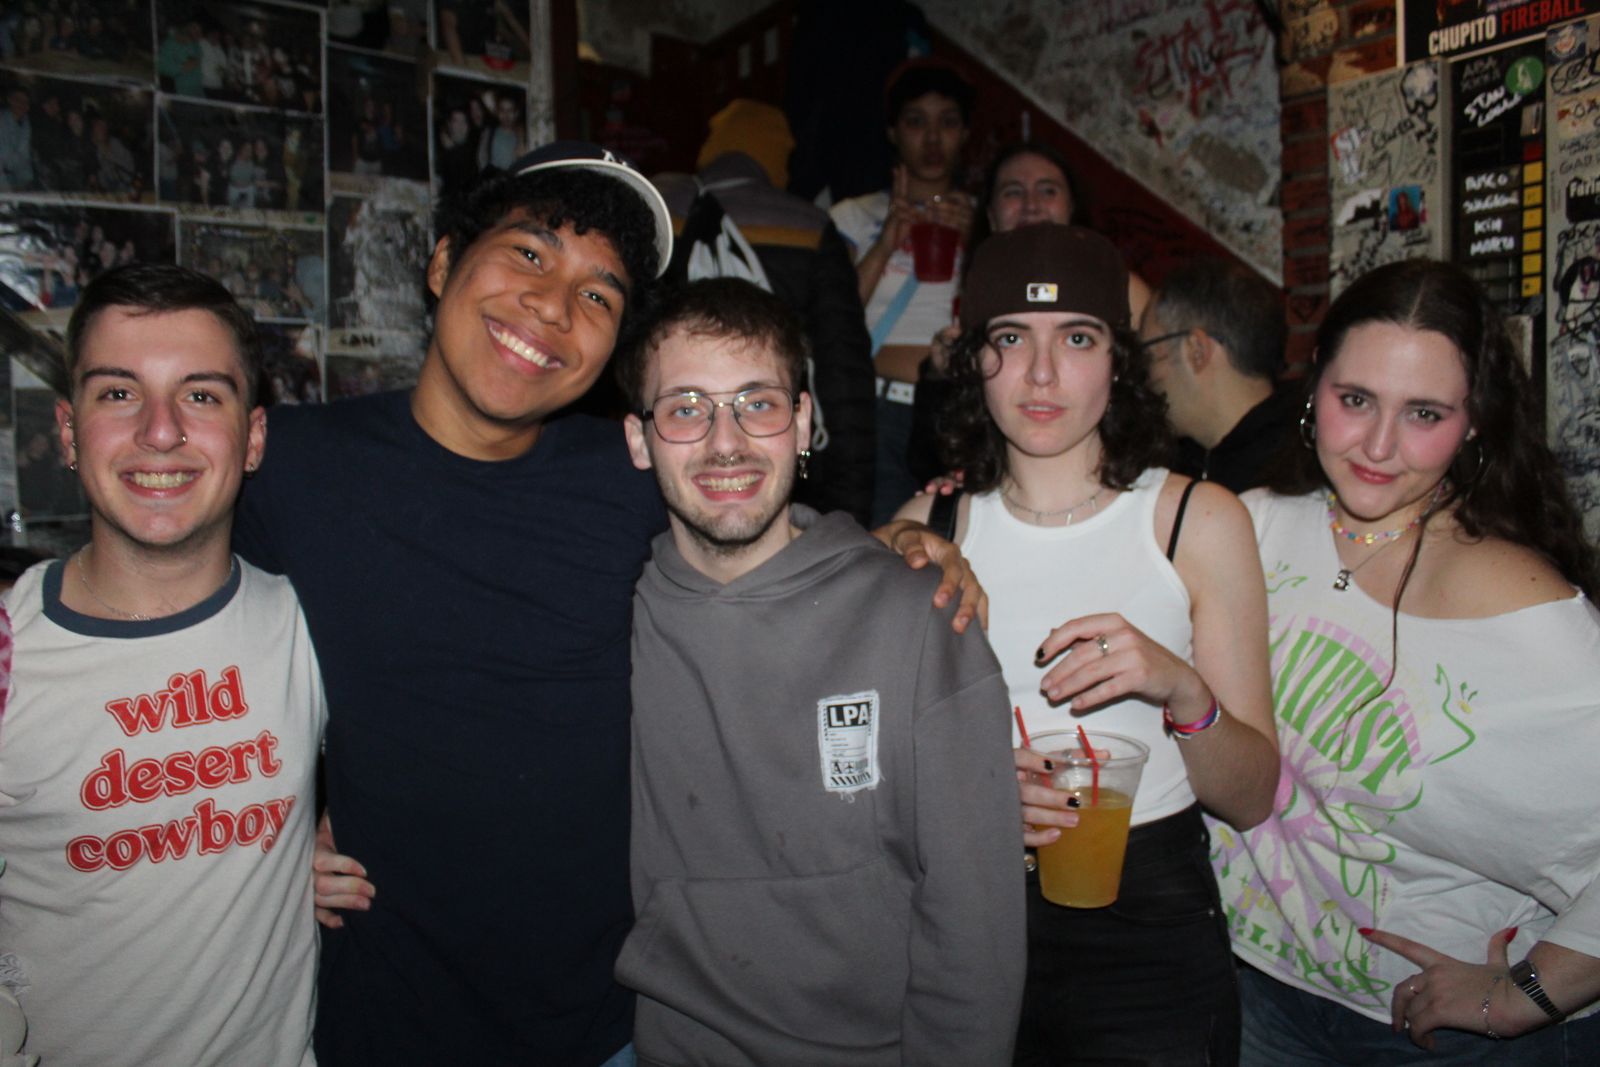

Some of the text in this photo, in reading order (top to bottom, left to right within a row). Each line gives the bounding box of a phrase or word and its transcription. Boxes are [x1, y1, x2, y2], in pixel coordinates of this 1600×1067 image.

[1428, 0, 1585, 56] CHUPITO FIREBALL
[105, 665, 248, 736] wild
[829, 704, 869, 727] LPA
[80, 730, 282, 810] desert
[66, 796, 296, 872] cowboy
